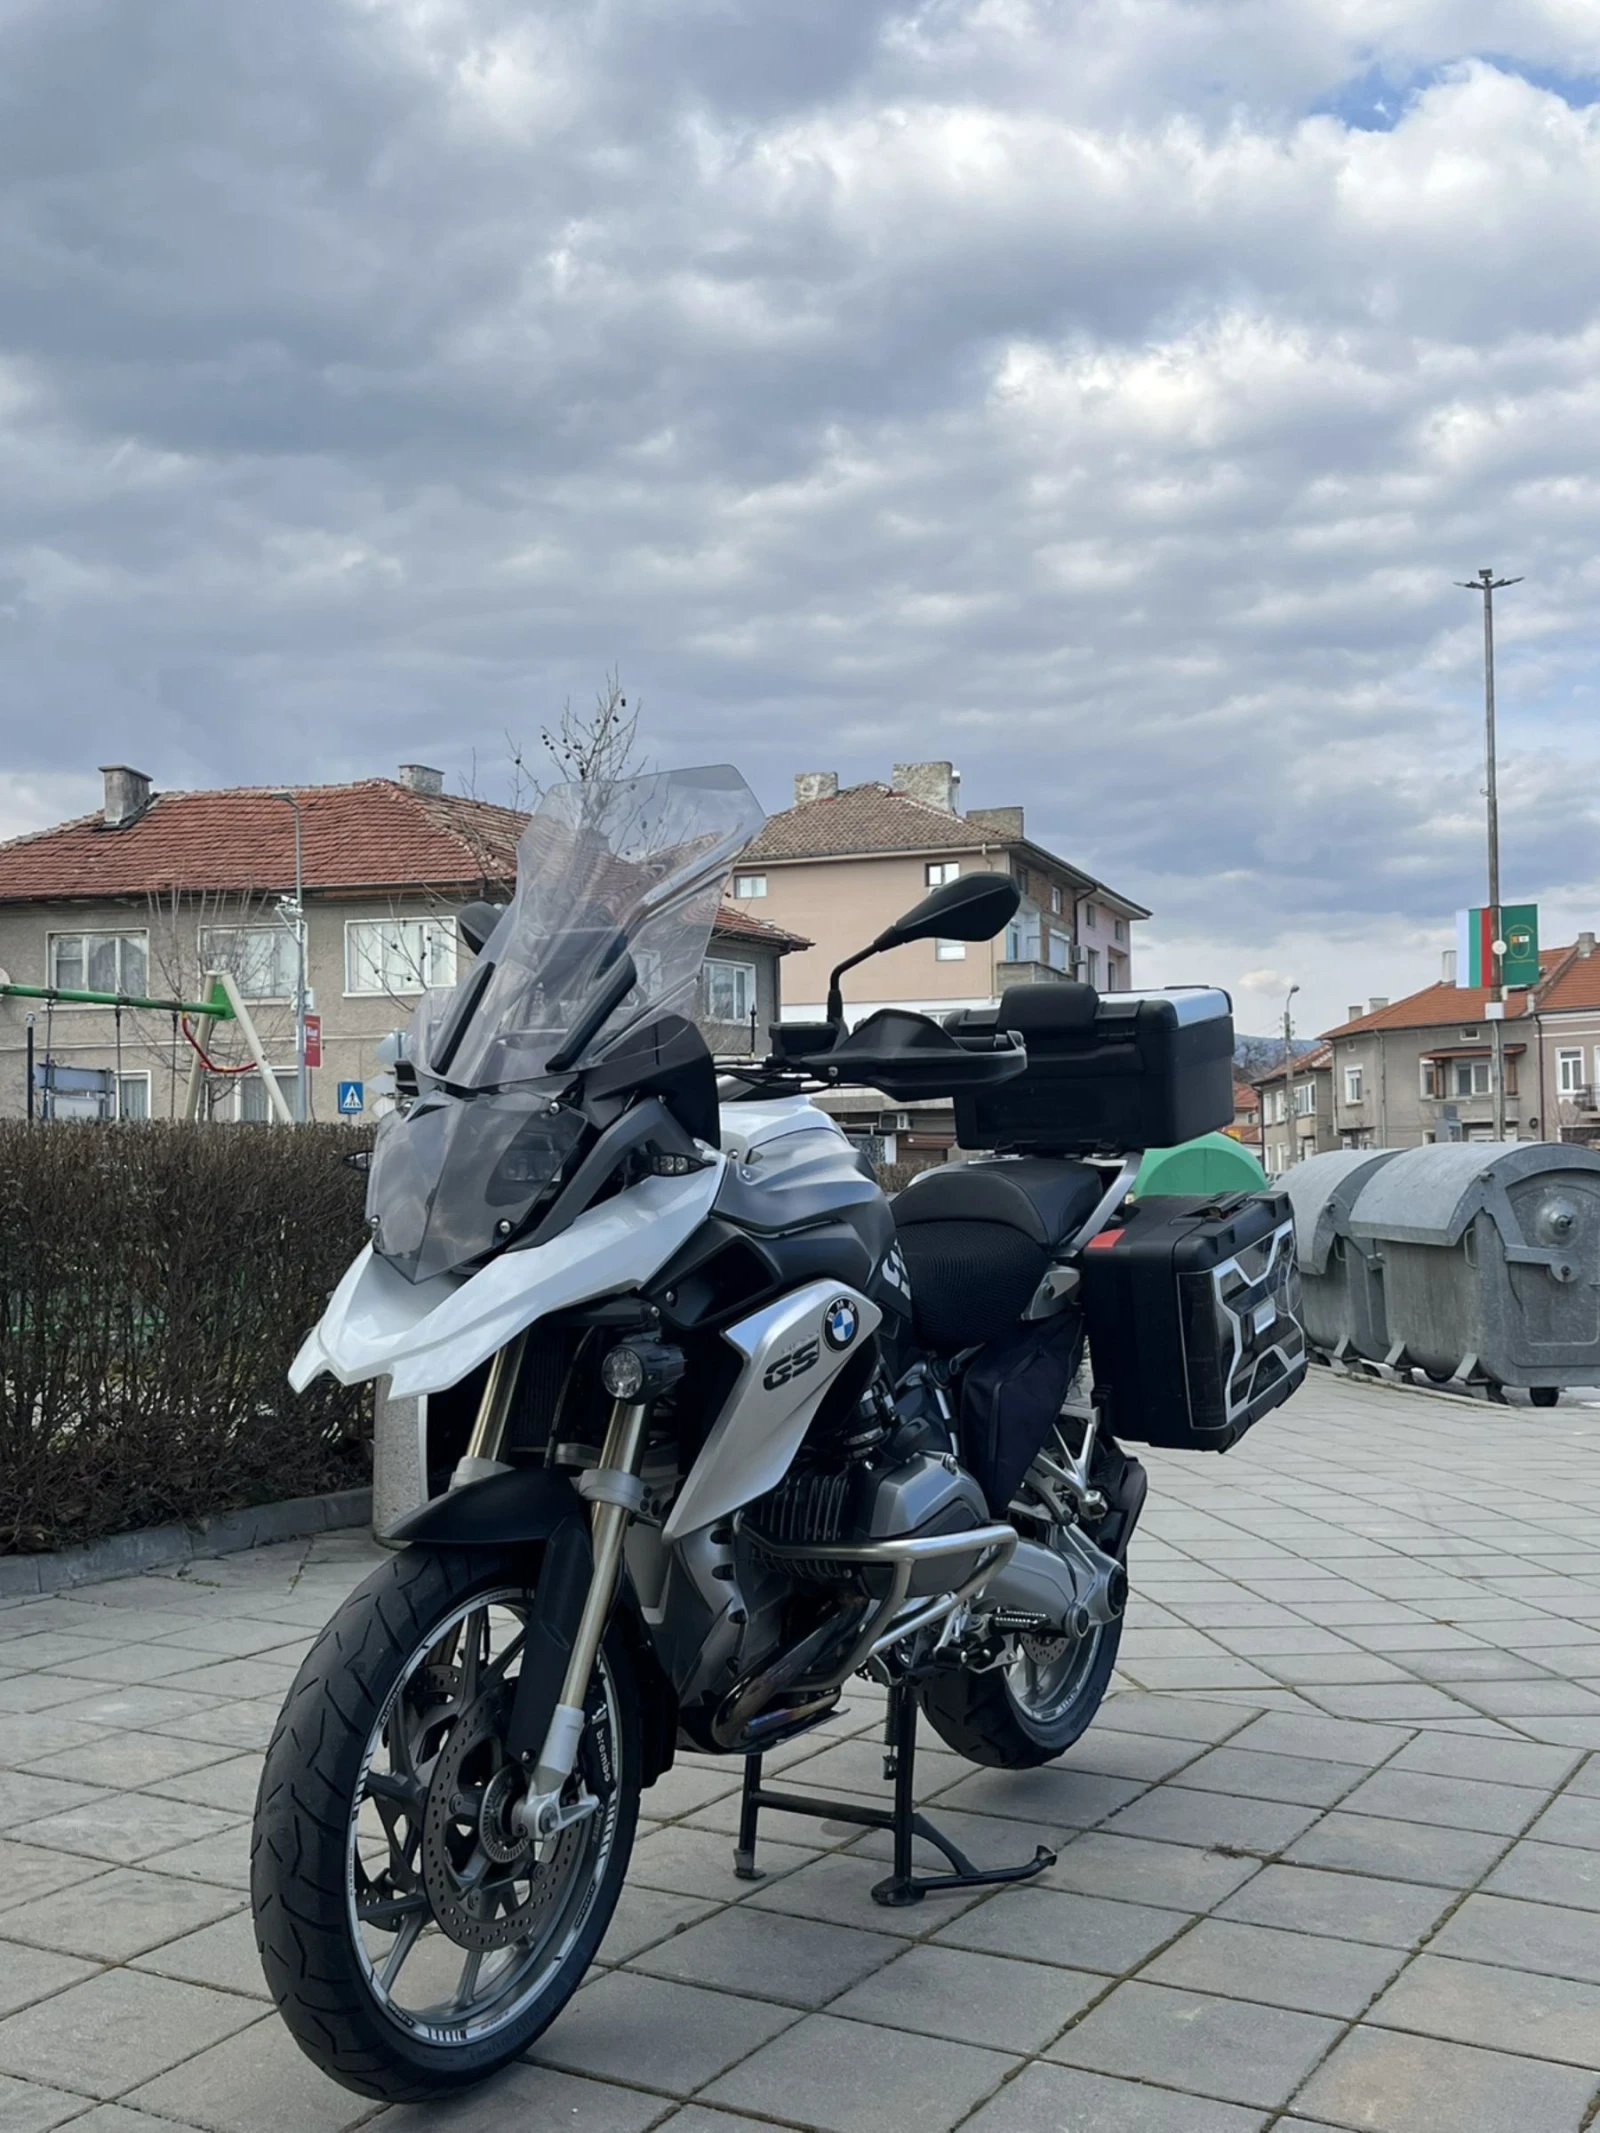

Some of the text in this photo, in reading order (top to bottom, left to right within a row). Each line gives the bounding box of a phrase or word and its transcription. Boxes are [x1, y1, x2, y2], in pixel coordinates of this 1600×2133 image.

[826, 1299, 855, 1323] BMW
[763, 1337, 820, 1391] GS
[596, 1727, 611, 1783] brembo
